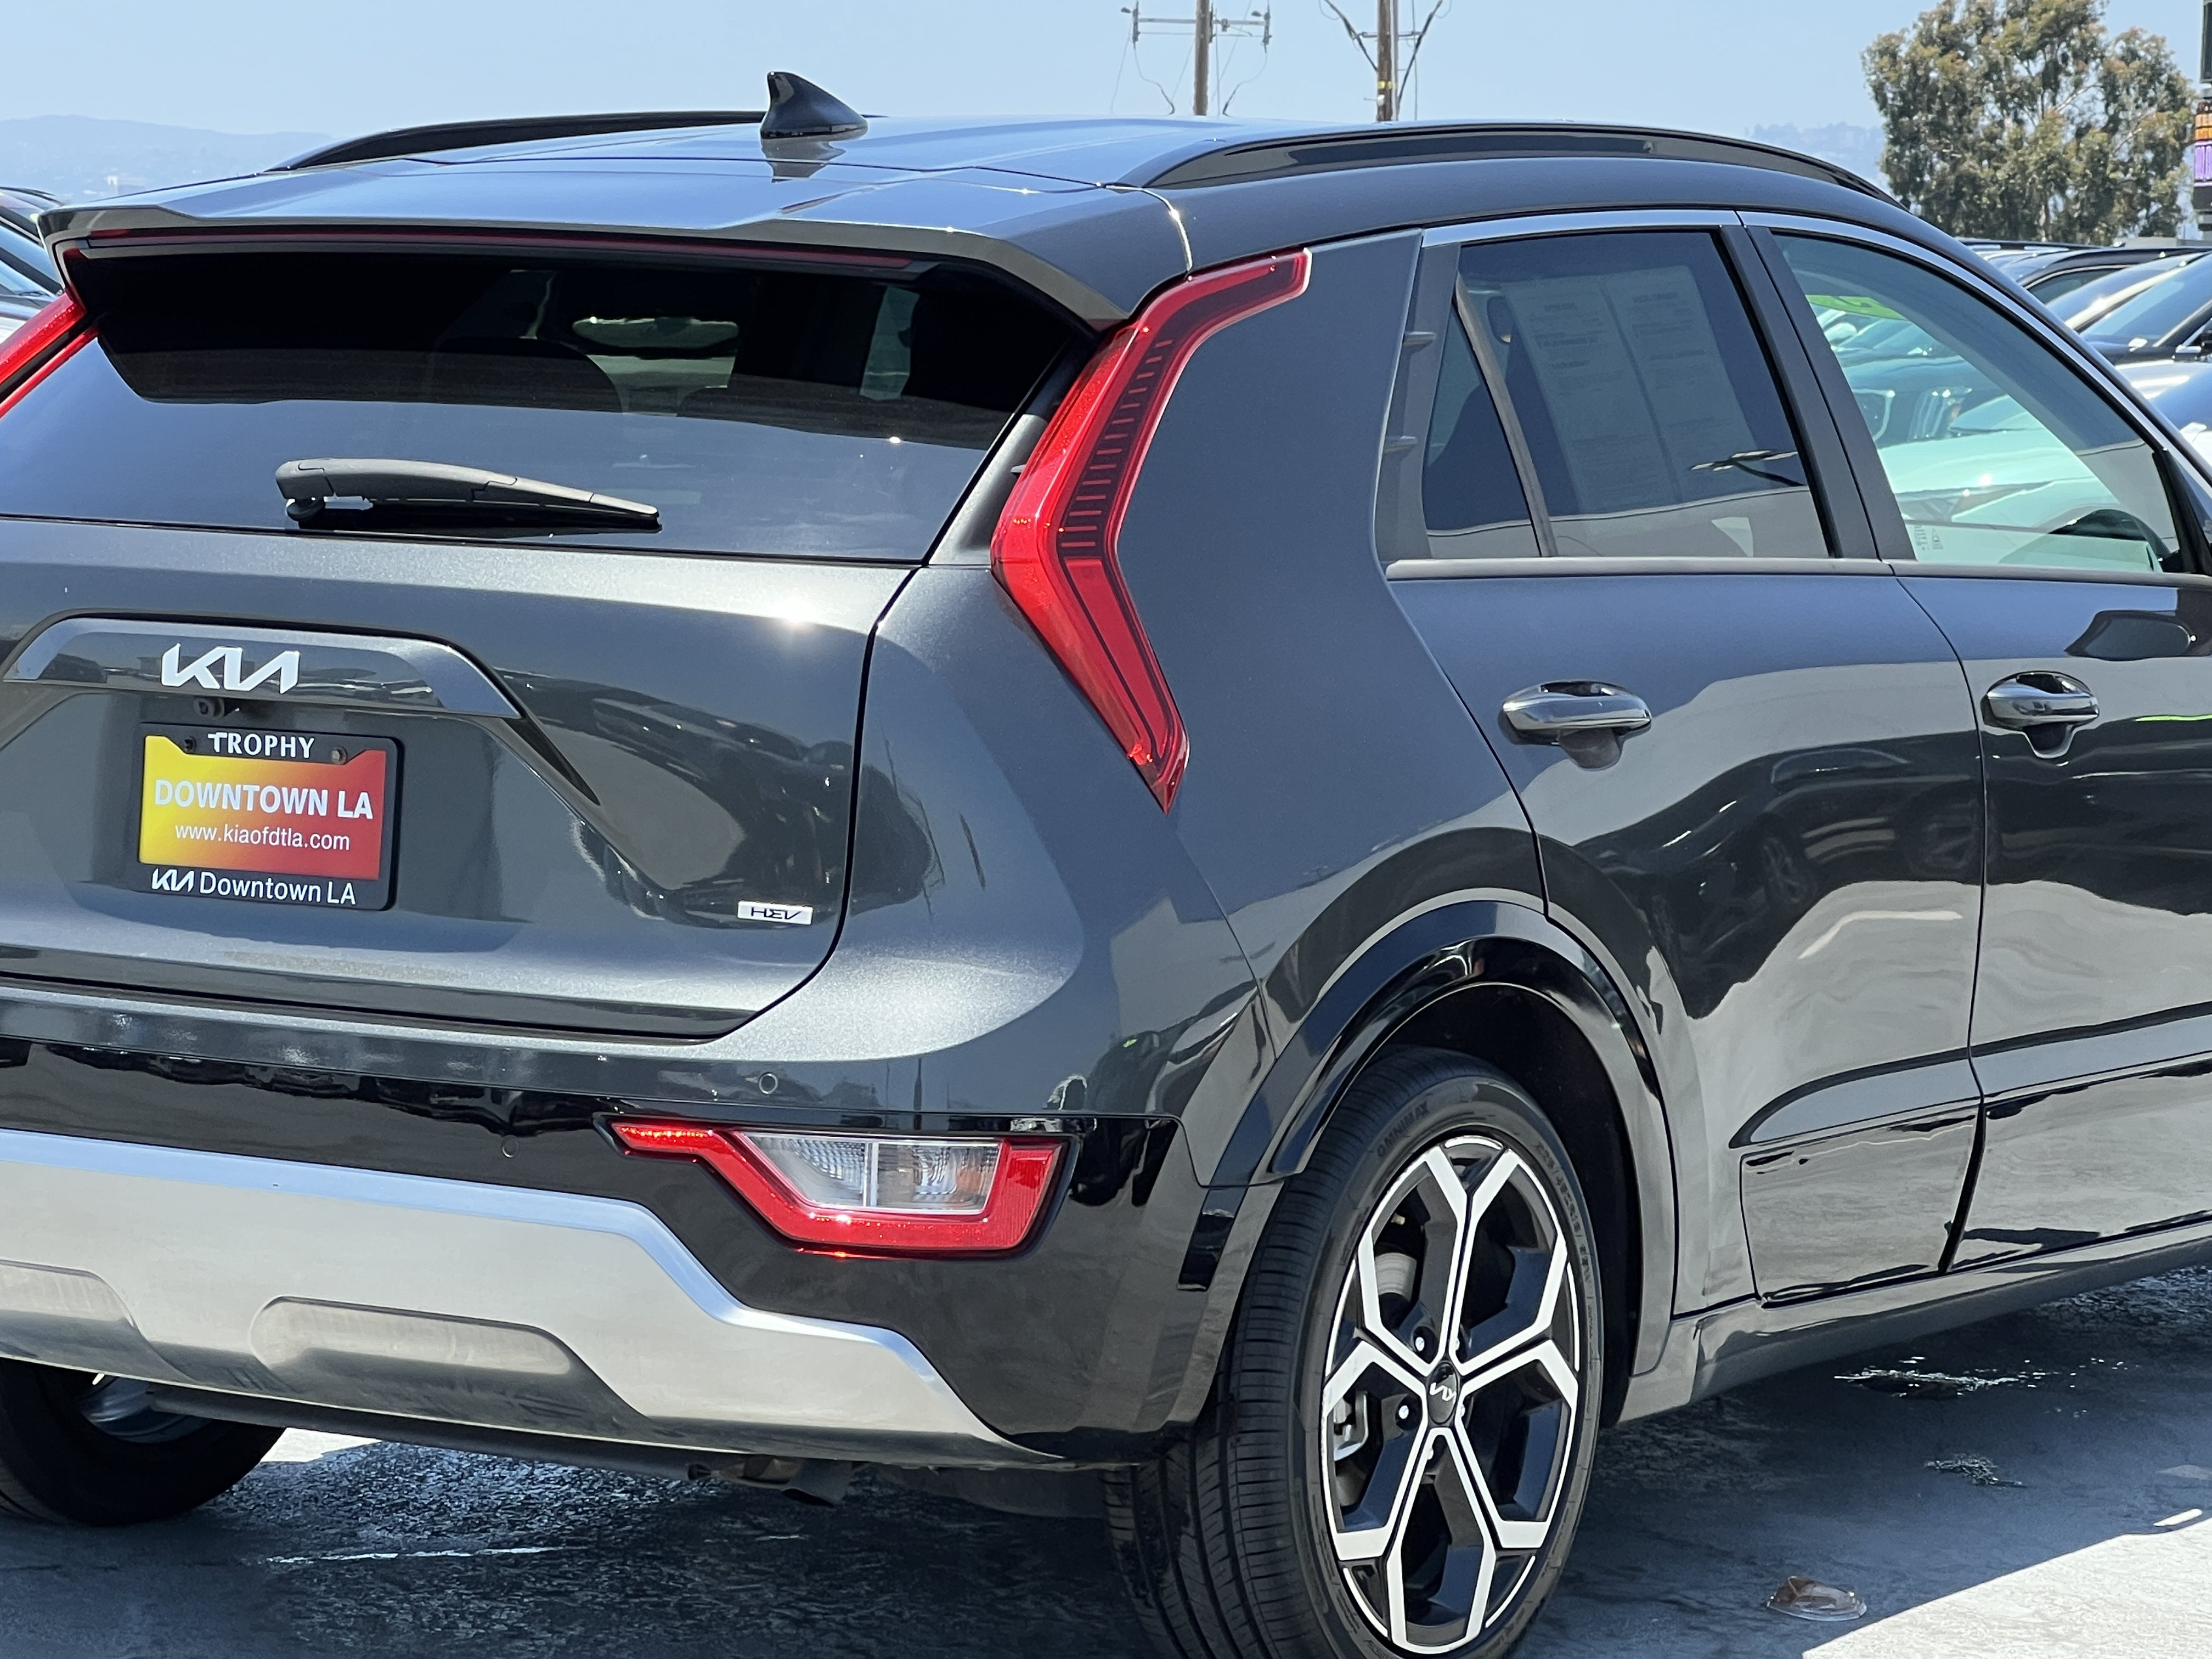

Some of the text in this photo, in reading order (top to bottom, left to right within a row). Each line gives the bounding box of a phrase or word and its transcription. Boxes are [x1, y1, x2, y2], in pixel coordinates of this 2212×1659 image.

[161, 643, 300, 695] KIA
[207, 731, 315, 759] TROPHY
[155, 779, 374, 820] DOWNTOWN LA
[175, 823, 350, 851] www.kiaofdtla.com
[151, 867, 356, 905] KIA Downtown LA
[751, 907, 803, 920] HEV
